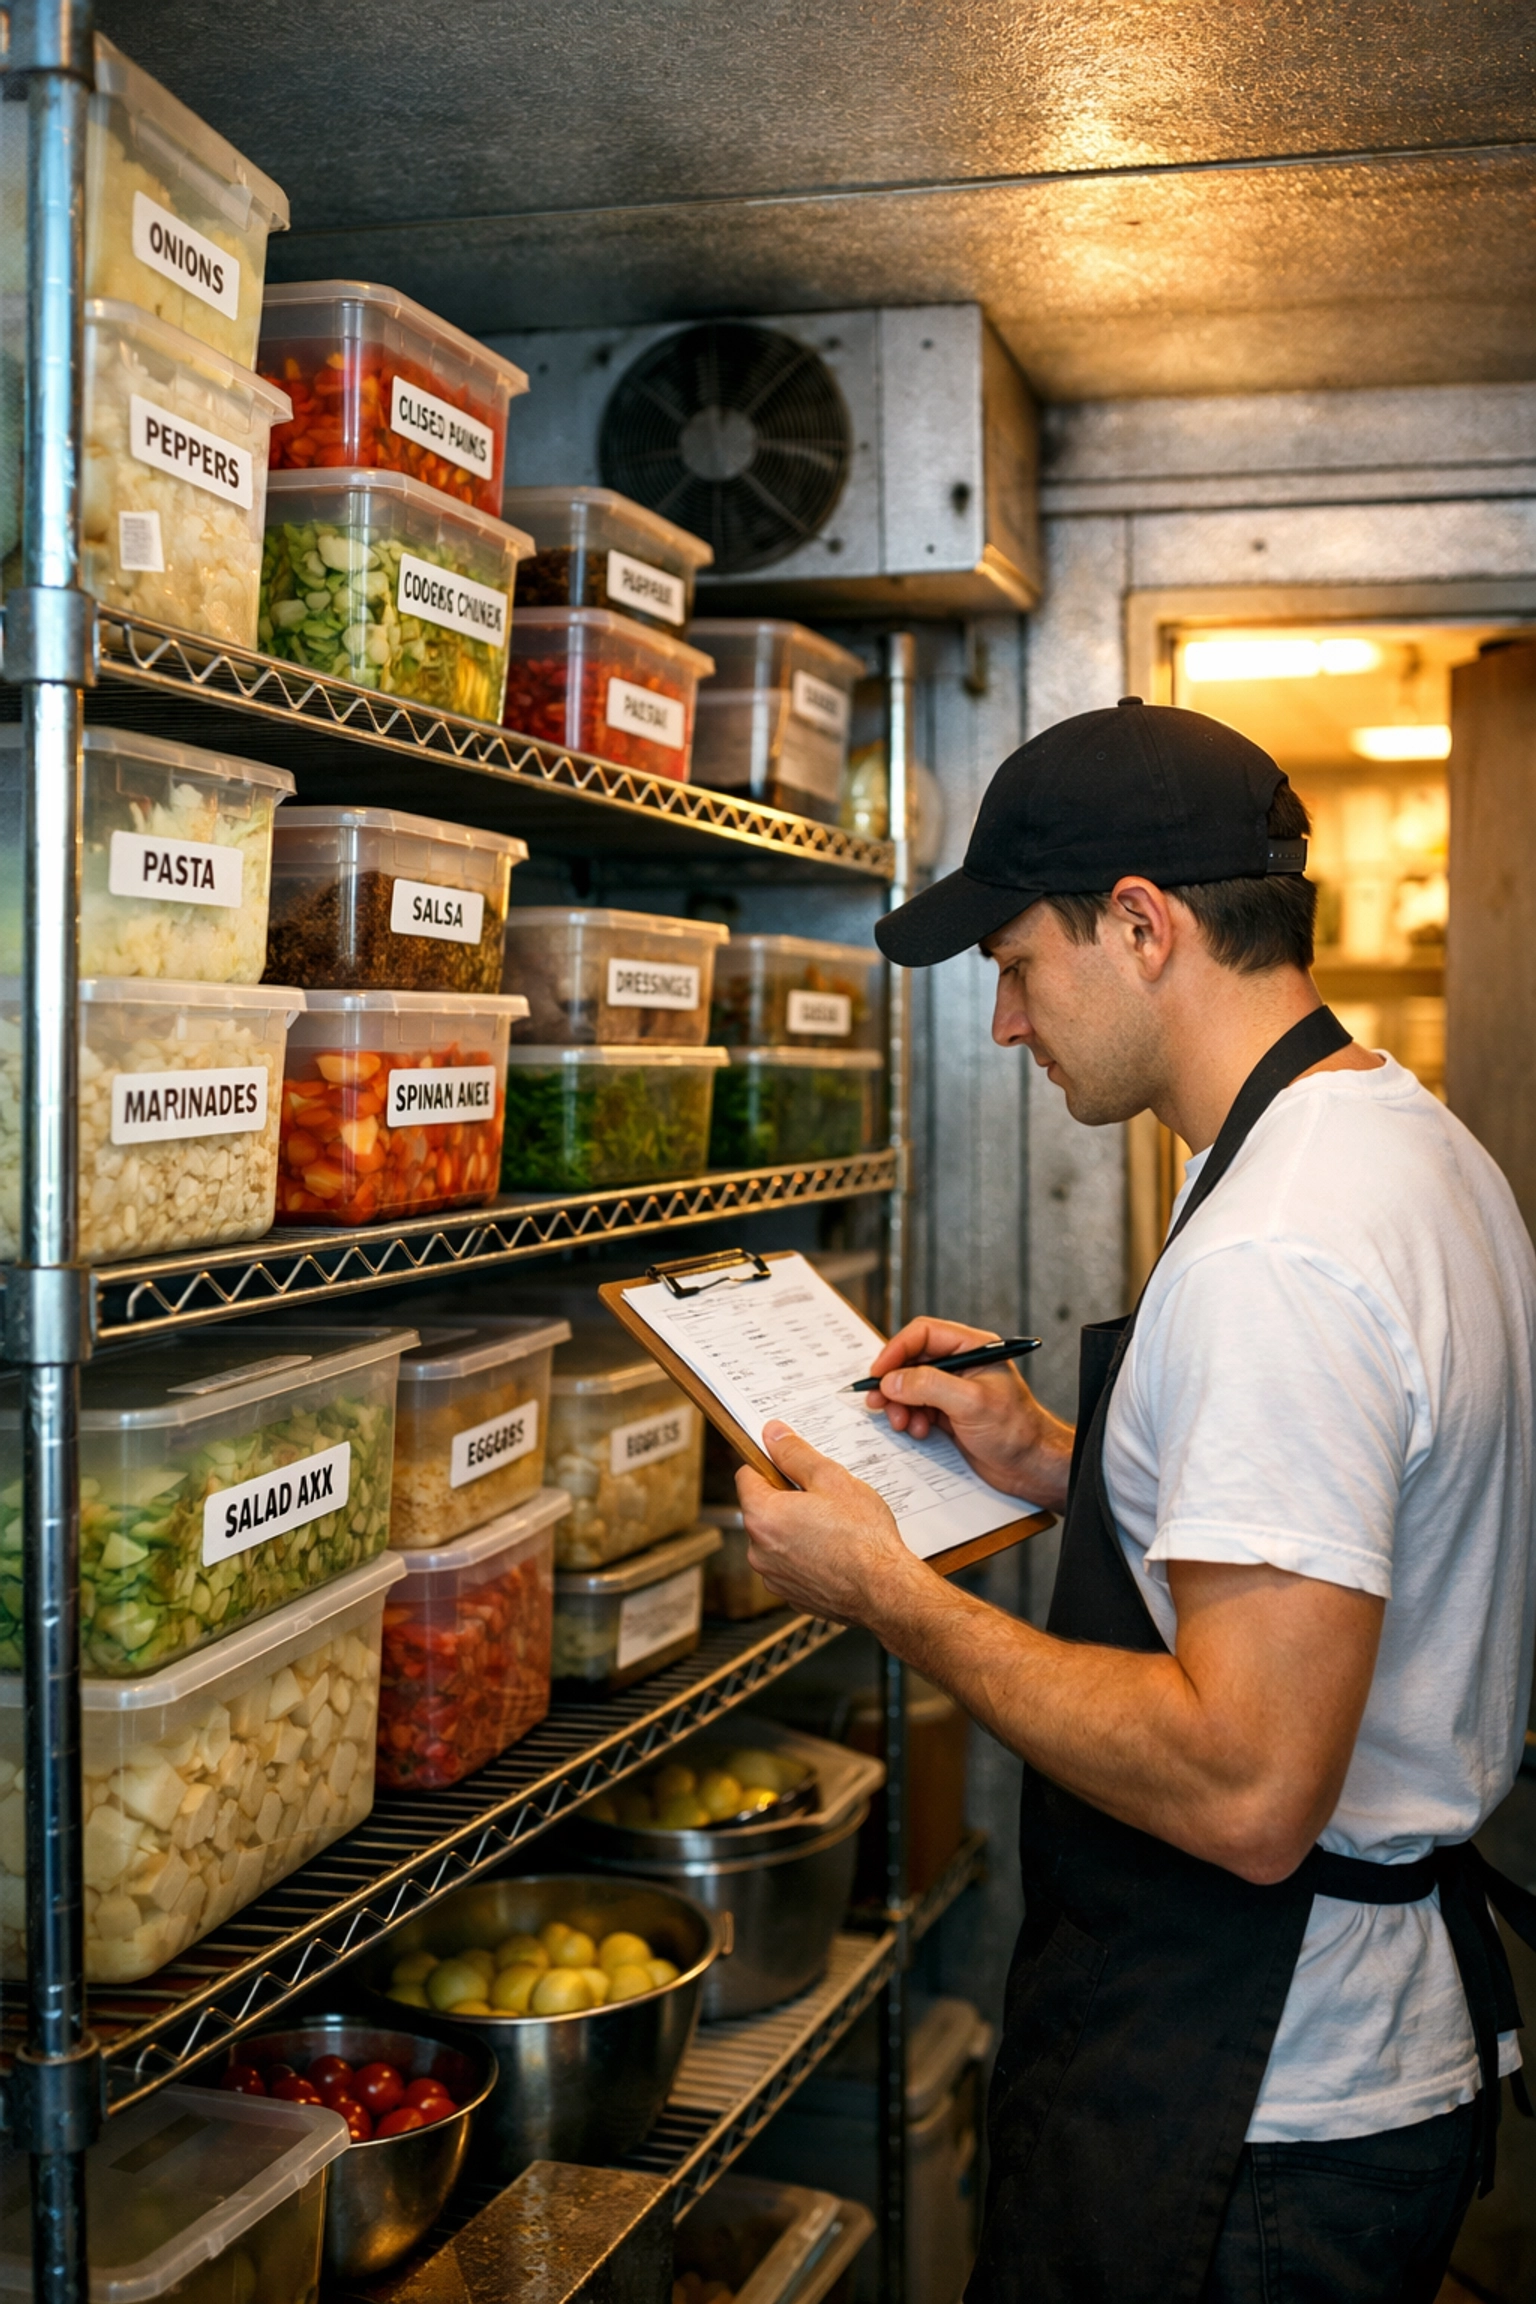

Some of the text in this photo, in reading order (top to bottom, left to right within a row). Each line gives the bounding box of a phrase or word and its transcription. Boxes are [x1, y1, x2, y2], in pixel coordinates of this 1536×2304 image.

[149, 221, 224, 295] ONIONS
[145, 415, 239, 489] PEPPERS
[143, 850, 215, 890] PASTA
[412, 896, 463, 928] SALSA
[124, 1083, 257, 1124] MARINADES
[225, 1463, 333, 1538] SALAD AXX
